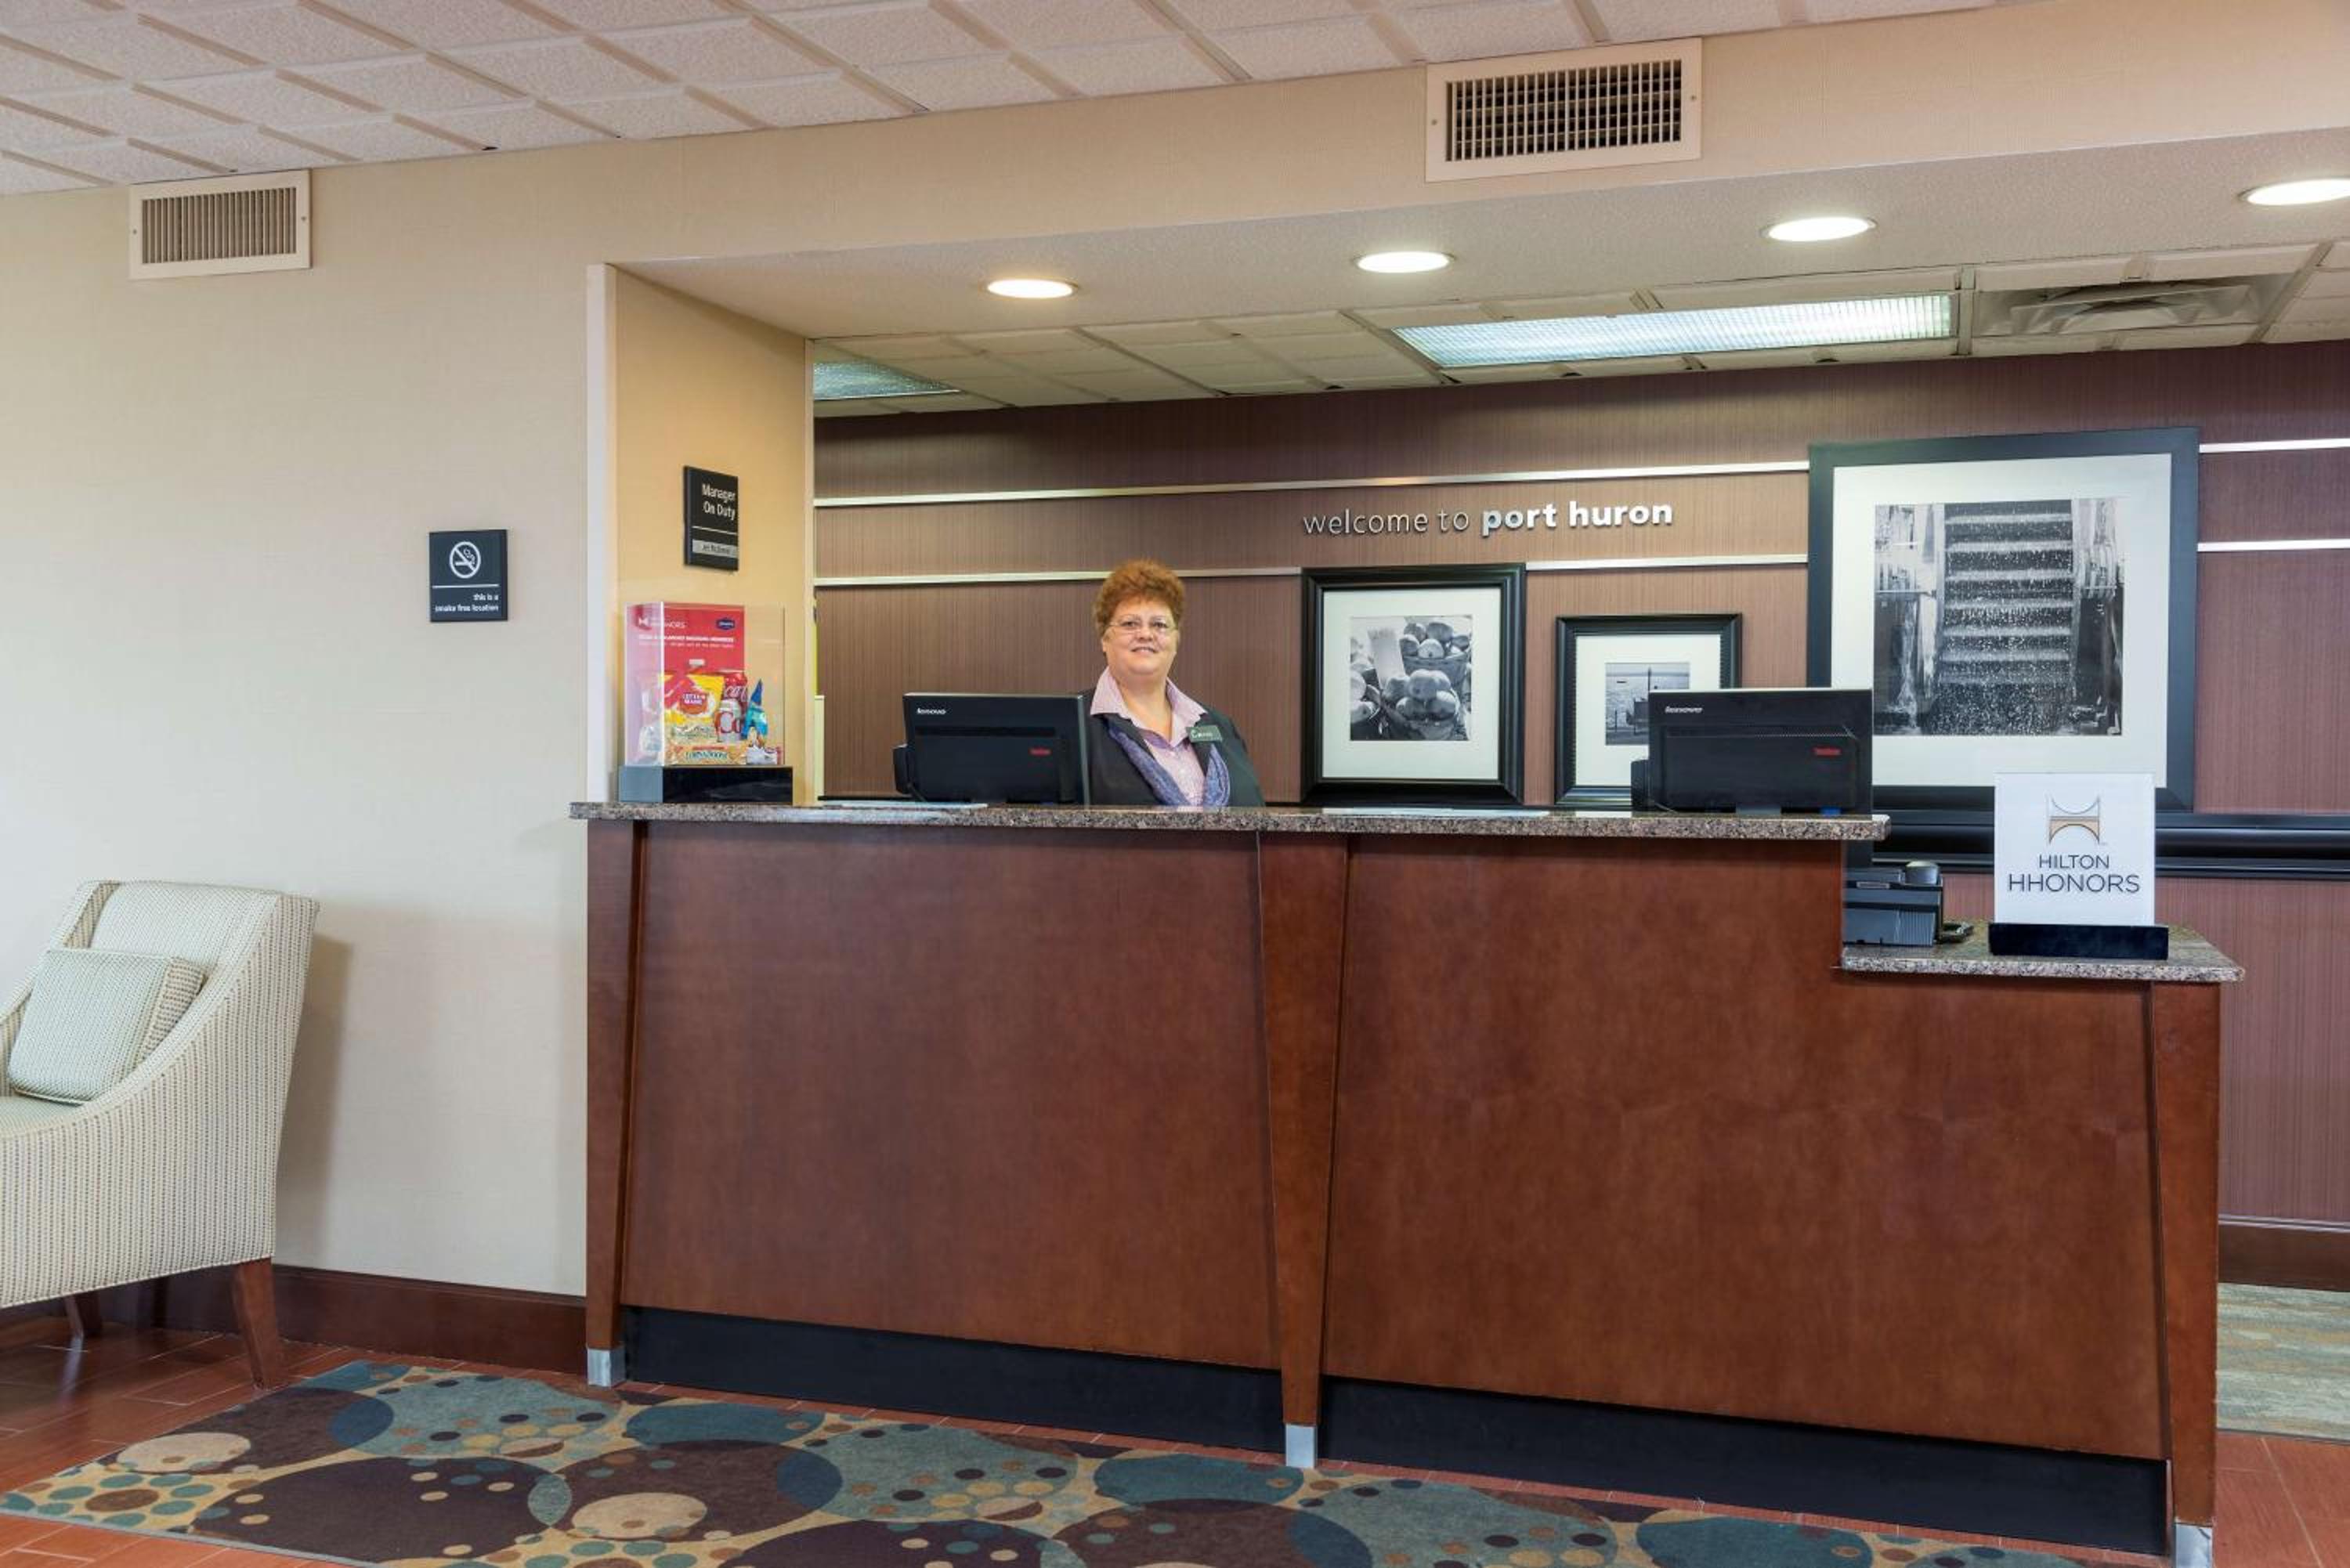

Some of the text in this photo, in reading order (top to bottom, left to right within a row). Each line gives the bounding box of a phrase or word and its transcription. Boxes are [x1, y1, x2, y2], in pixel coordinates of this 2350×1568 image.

[702, 483, 736, 504] Manager
[703, 500, 736, 521] On Duty
[1303, 500, 1673, 537] welcome to port huron
[2039, 854, 2110, 869] HILTON
[2008, 873, 2141, 893] HHONORS
